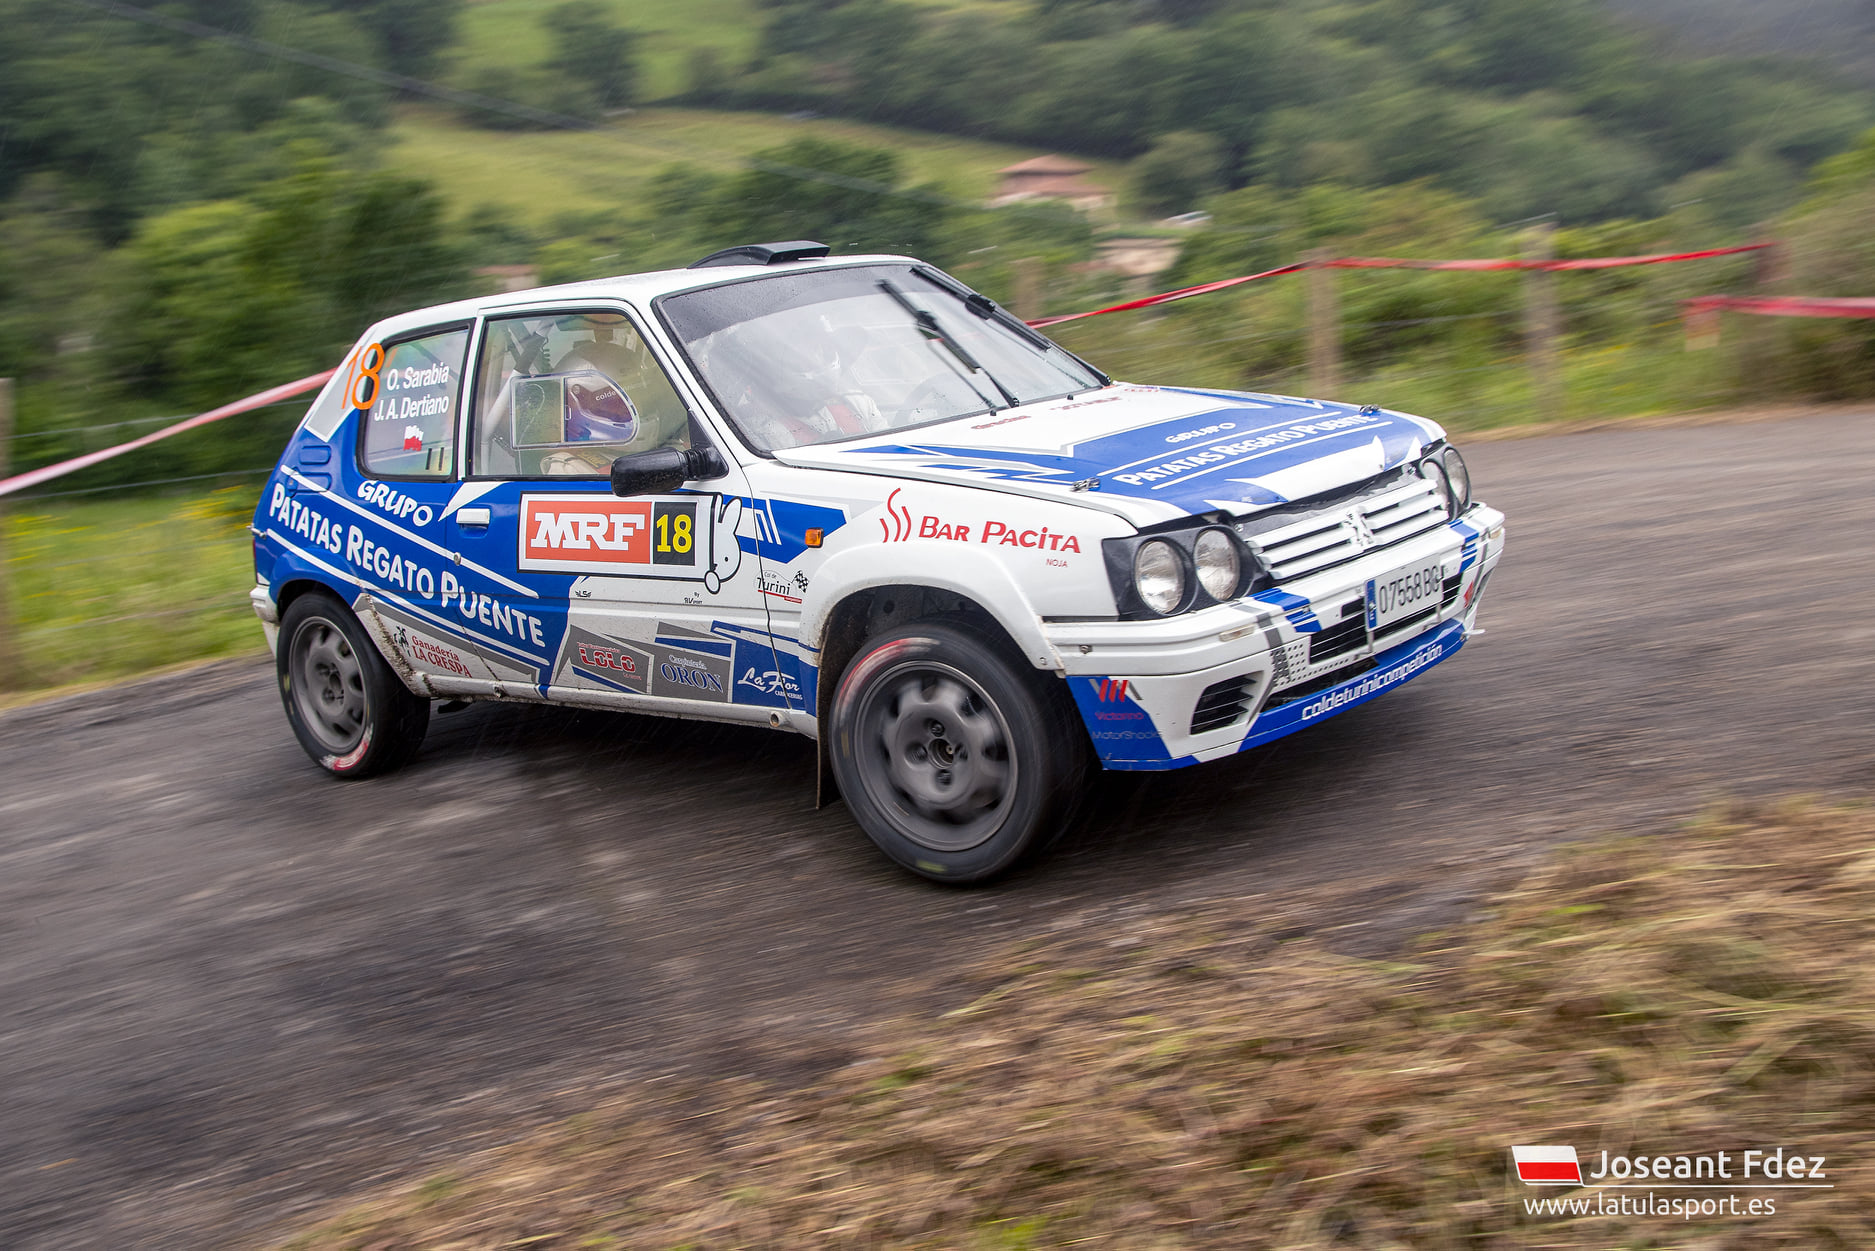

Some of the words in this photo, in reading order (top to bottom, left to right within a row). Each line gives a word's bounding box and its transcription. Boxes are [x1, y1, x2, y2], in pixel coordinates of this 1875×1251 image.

[341, 342, 385, 410] 18
[386, 371, 400, 390] O.
[402, 361, 449, 389] Sarabia
[374, 404, 385, 421] J.
[386, 402, 399, 420] A.
[400, 393, 449, 418] Dertiano
[1164, 421, 1237, 444] GRUPO
[1111, 447, 1222, 486] PATATAS
[1217, 429, 1305, 457] REGATO
[1299, 413, 1379, 436] PUENTE
[357, 479, 434, 527] GRUPO
[530, 512, 646, 551] MRF
[655, 514, 693, 554] 18
[918, 515, 970, 542] BAR
[269, 482, 343, 554] PATATAS
[346, 524, 434, 600] REGATO
[440, 570, 546, 648] PUENTE
[757, 577, 791, 595] Turini
[412, 645, 429, 663] LA
[427, 651, 473, 679] CRESPA
[579, 647, 636, 673] LOLO
[660, 663, 724, 693] ORON
[737, 667, 766, 692] La
